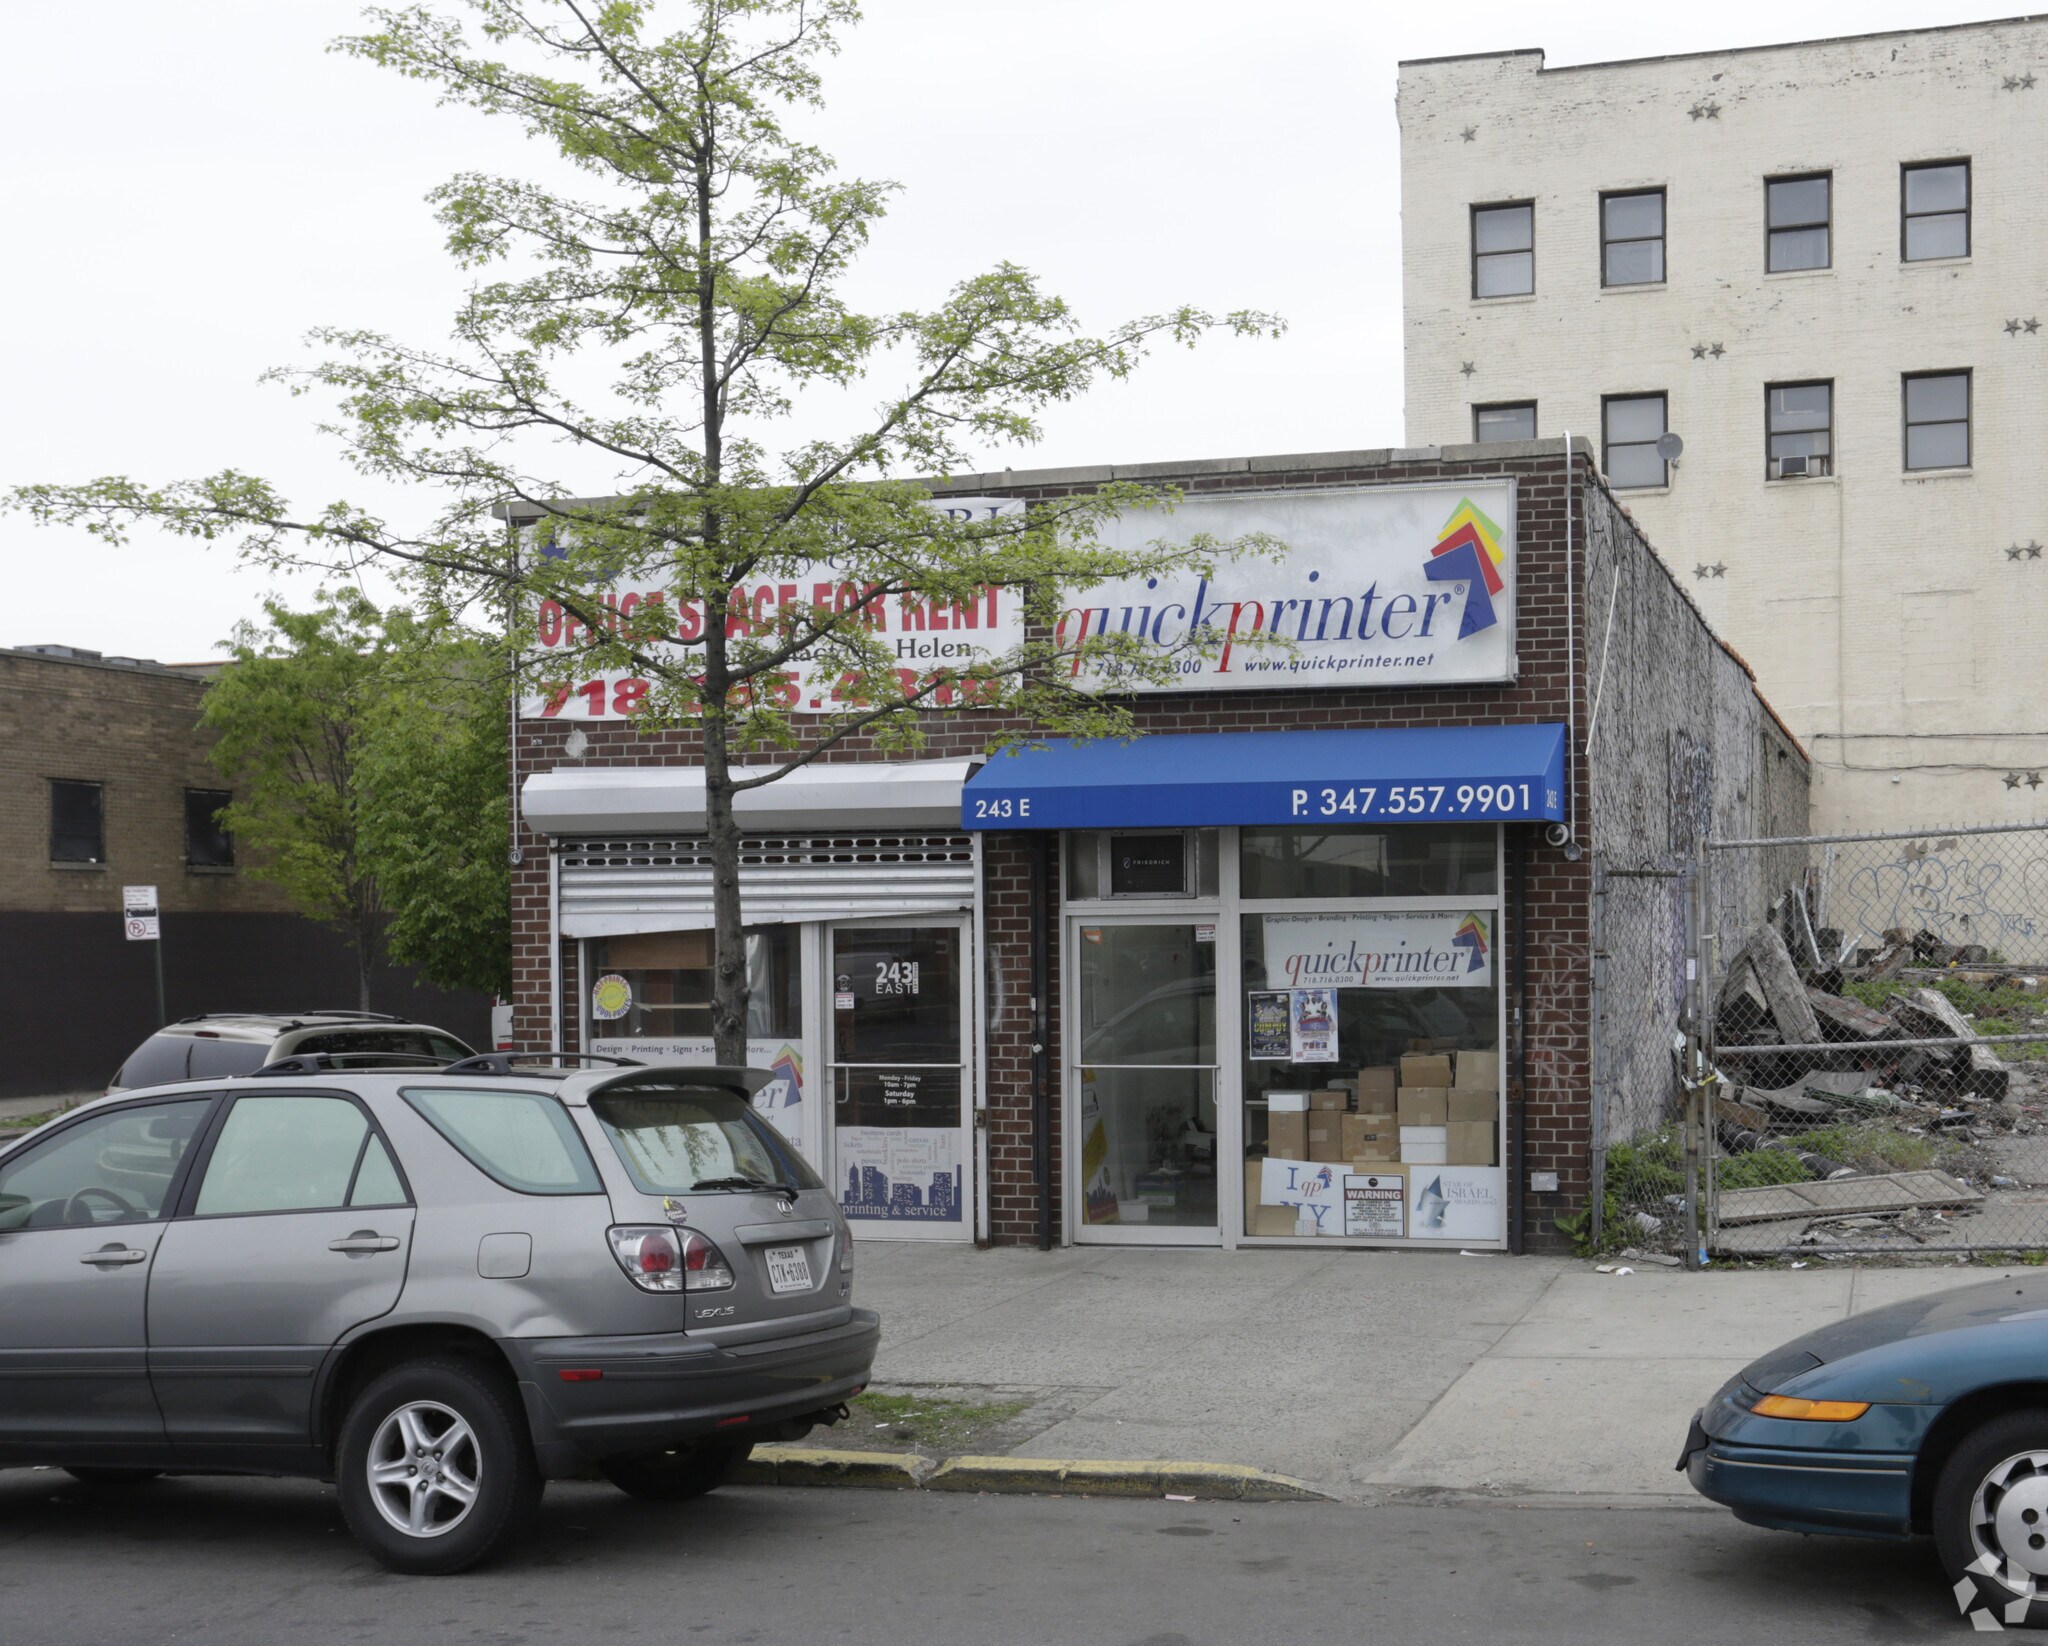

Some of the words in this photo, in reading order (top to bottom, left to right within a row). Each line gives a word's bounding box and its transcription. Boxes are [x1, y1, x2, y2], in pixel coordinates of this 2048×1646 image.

[1056, 570, 1451, 677] quickprinter
[897, 637, 972, 659] Helen
[1244, 653, 1434, 674] www.quickprinter.net
[1292, 790, 1308, 815] P.
[1320, 784, 1529, 815] 347.557.9901
[976, 800, 1012, 818] 243
[1020, 799, 1030, 817] E
[1352, 914, 1377, 922] Printing
[1285, 940, 1464, 986] quickprinter
[876, 962, 913, 983] 243
[1303, 976, 1353, 984] 718.716.0300
[1375, 975, 1459, 983] www.quickprinter.net
[876, 984, 913, 994] EAST
[596, 1045, 622, 1054] Design
[631, 1045, 663, 1054] Printing
[672, 1045, 692, 1054] Signs
[879, 1075, 900, 1083] Monday
[904, 1075, 921, 1083] Friday
[885, 1090, 914, 1098] Saturday
[1286, 1167, 1299, 1190] I
[1302, 1181, 1321, 1197] qp
[1346, 1190, 1401, 1200] WARNING
[1447, 1188, 1493, 1199] ISRAEL
[842, 1204, 888, 1218] printing
[892, 1205, 901, 1215] &
[905, 1206, 947, 1216] service
[778, 1251, 793, 1260] TEXAS
[695, 1306, 735, 1318] LEXUS
